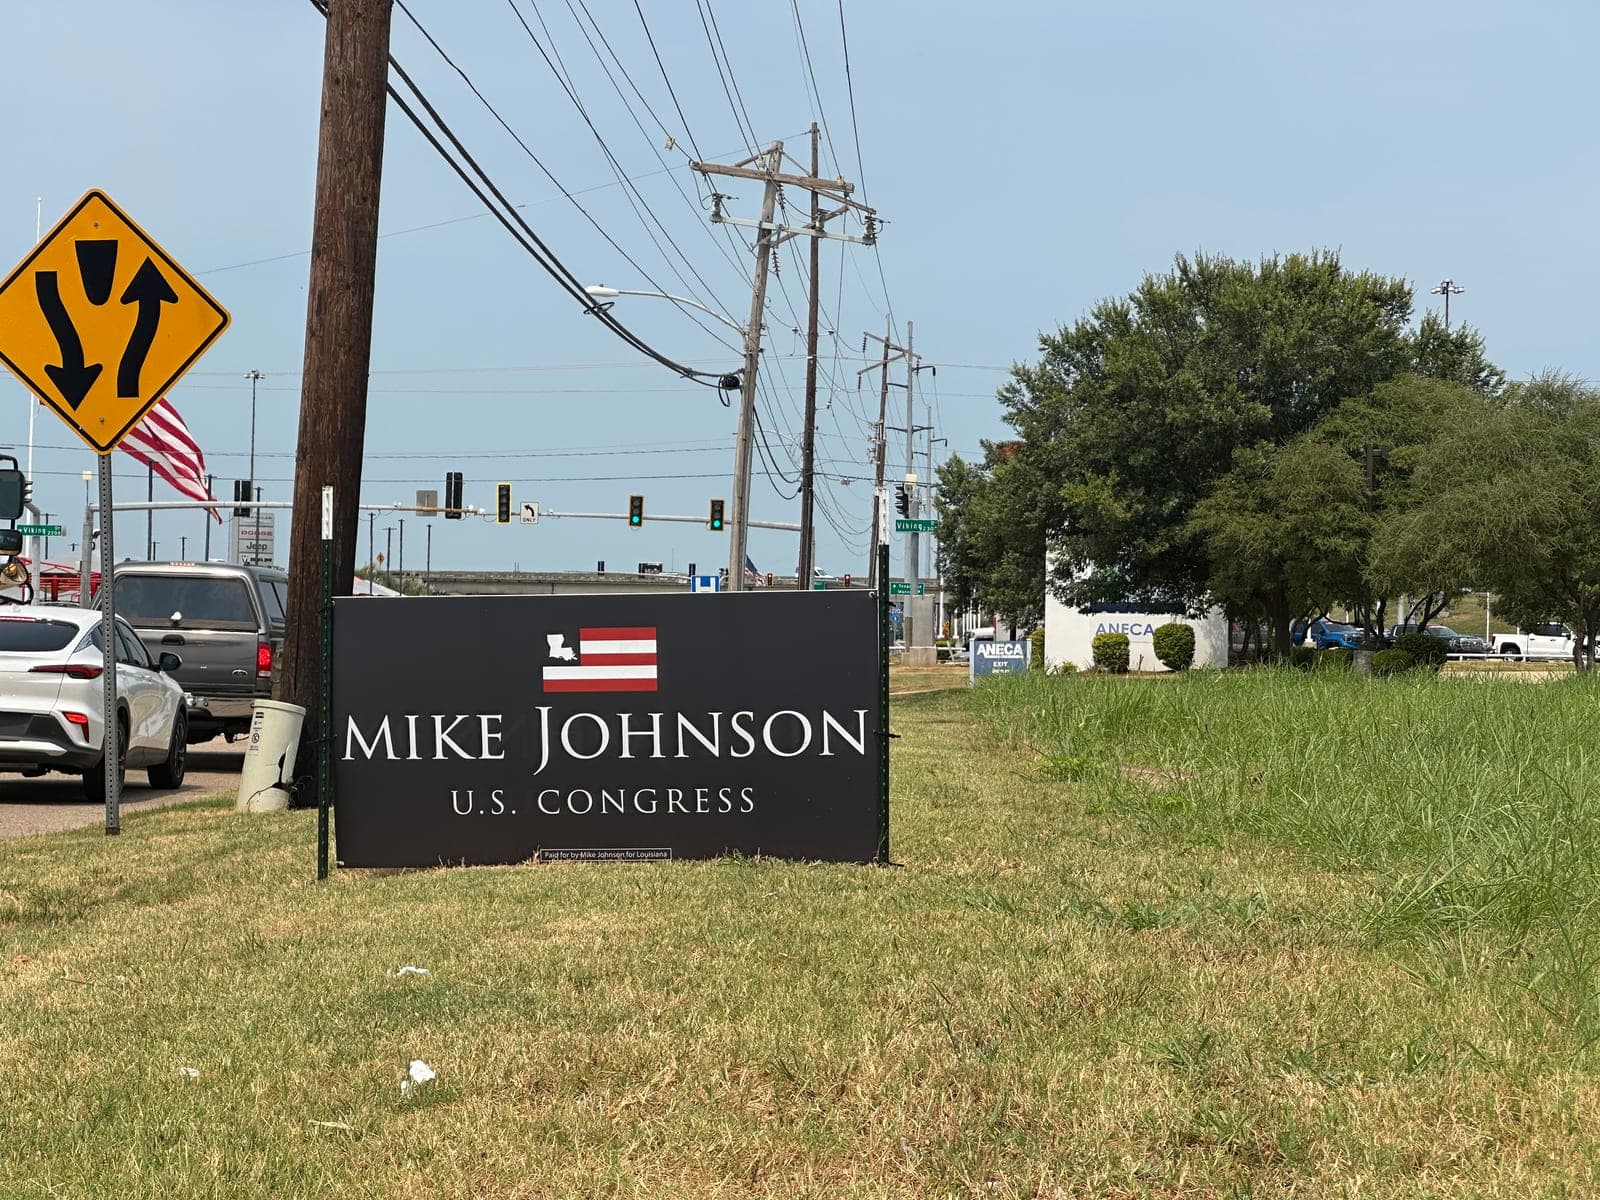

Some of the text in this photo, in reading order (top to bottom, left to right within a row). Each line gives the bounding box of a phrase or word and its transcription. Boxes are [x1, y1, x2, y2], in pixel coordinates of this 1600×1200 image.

[897, 521, 923, 531] Viking
[1095, 623, 1154, 636] ANECA
[977, 643, 1023, 656] ANECA
[341, 706, 869, 776] MIKE JOHNSON
[450, 787, 754, 815] U.S. CONGRESS
[570, 851, 579, 859] by
[597, 850, 625, 858] Johnson
[625, 850, 636, 858] for
[636, 850, 668, 858] Louisiana
